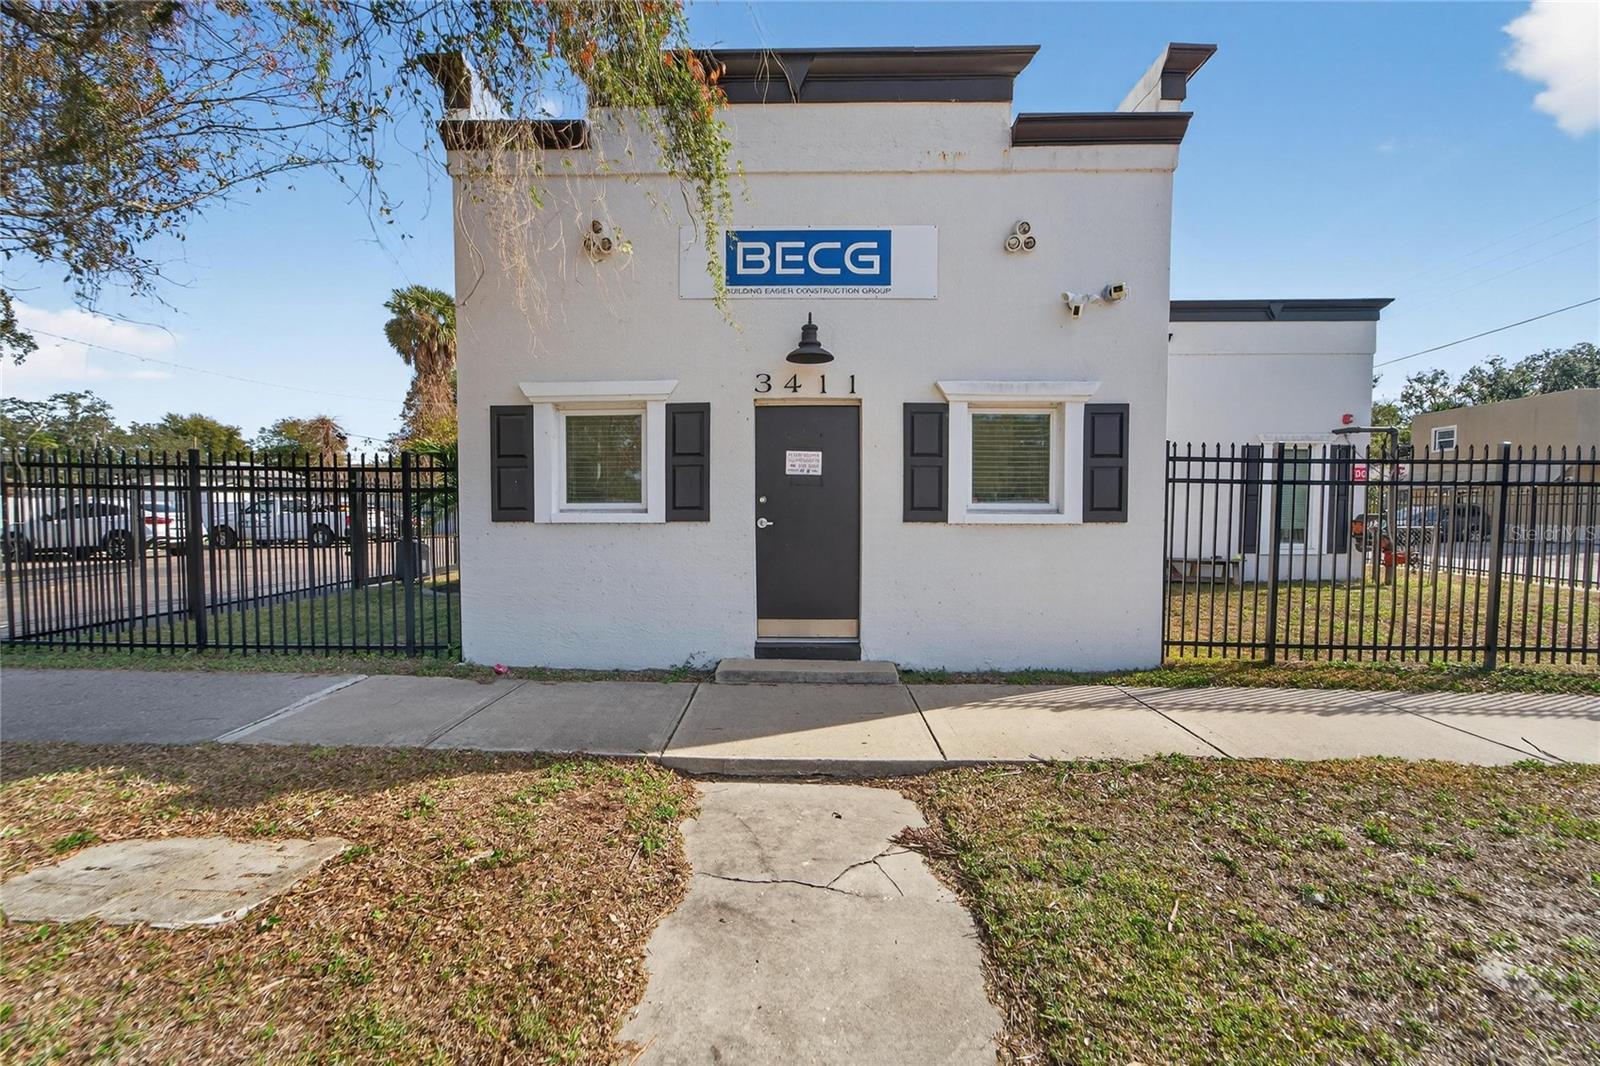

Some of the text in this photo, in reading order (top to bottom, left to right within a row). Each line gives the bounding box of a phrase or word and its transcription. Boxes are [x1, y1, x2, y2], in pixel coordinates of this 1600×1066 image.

[737, 241, 880, 275] BECG
[796, 287, 860, 295] CONSTRUCTION
[861, 287, 892, 295] GROUP
